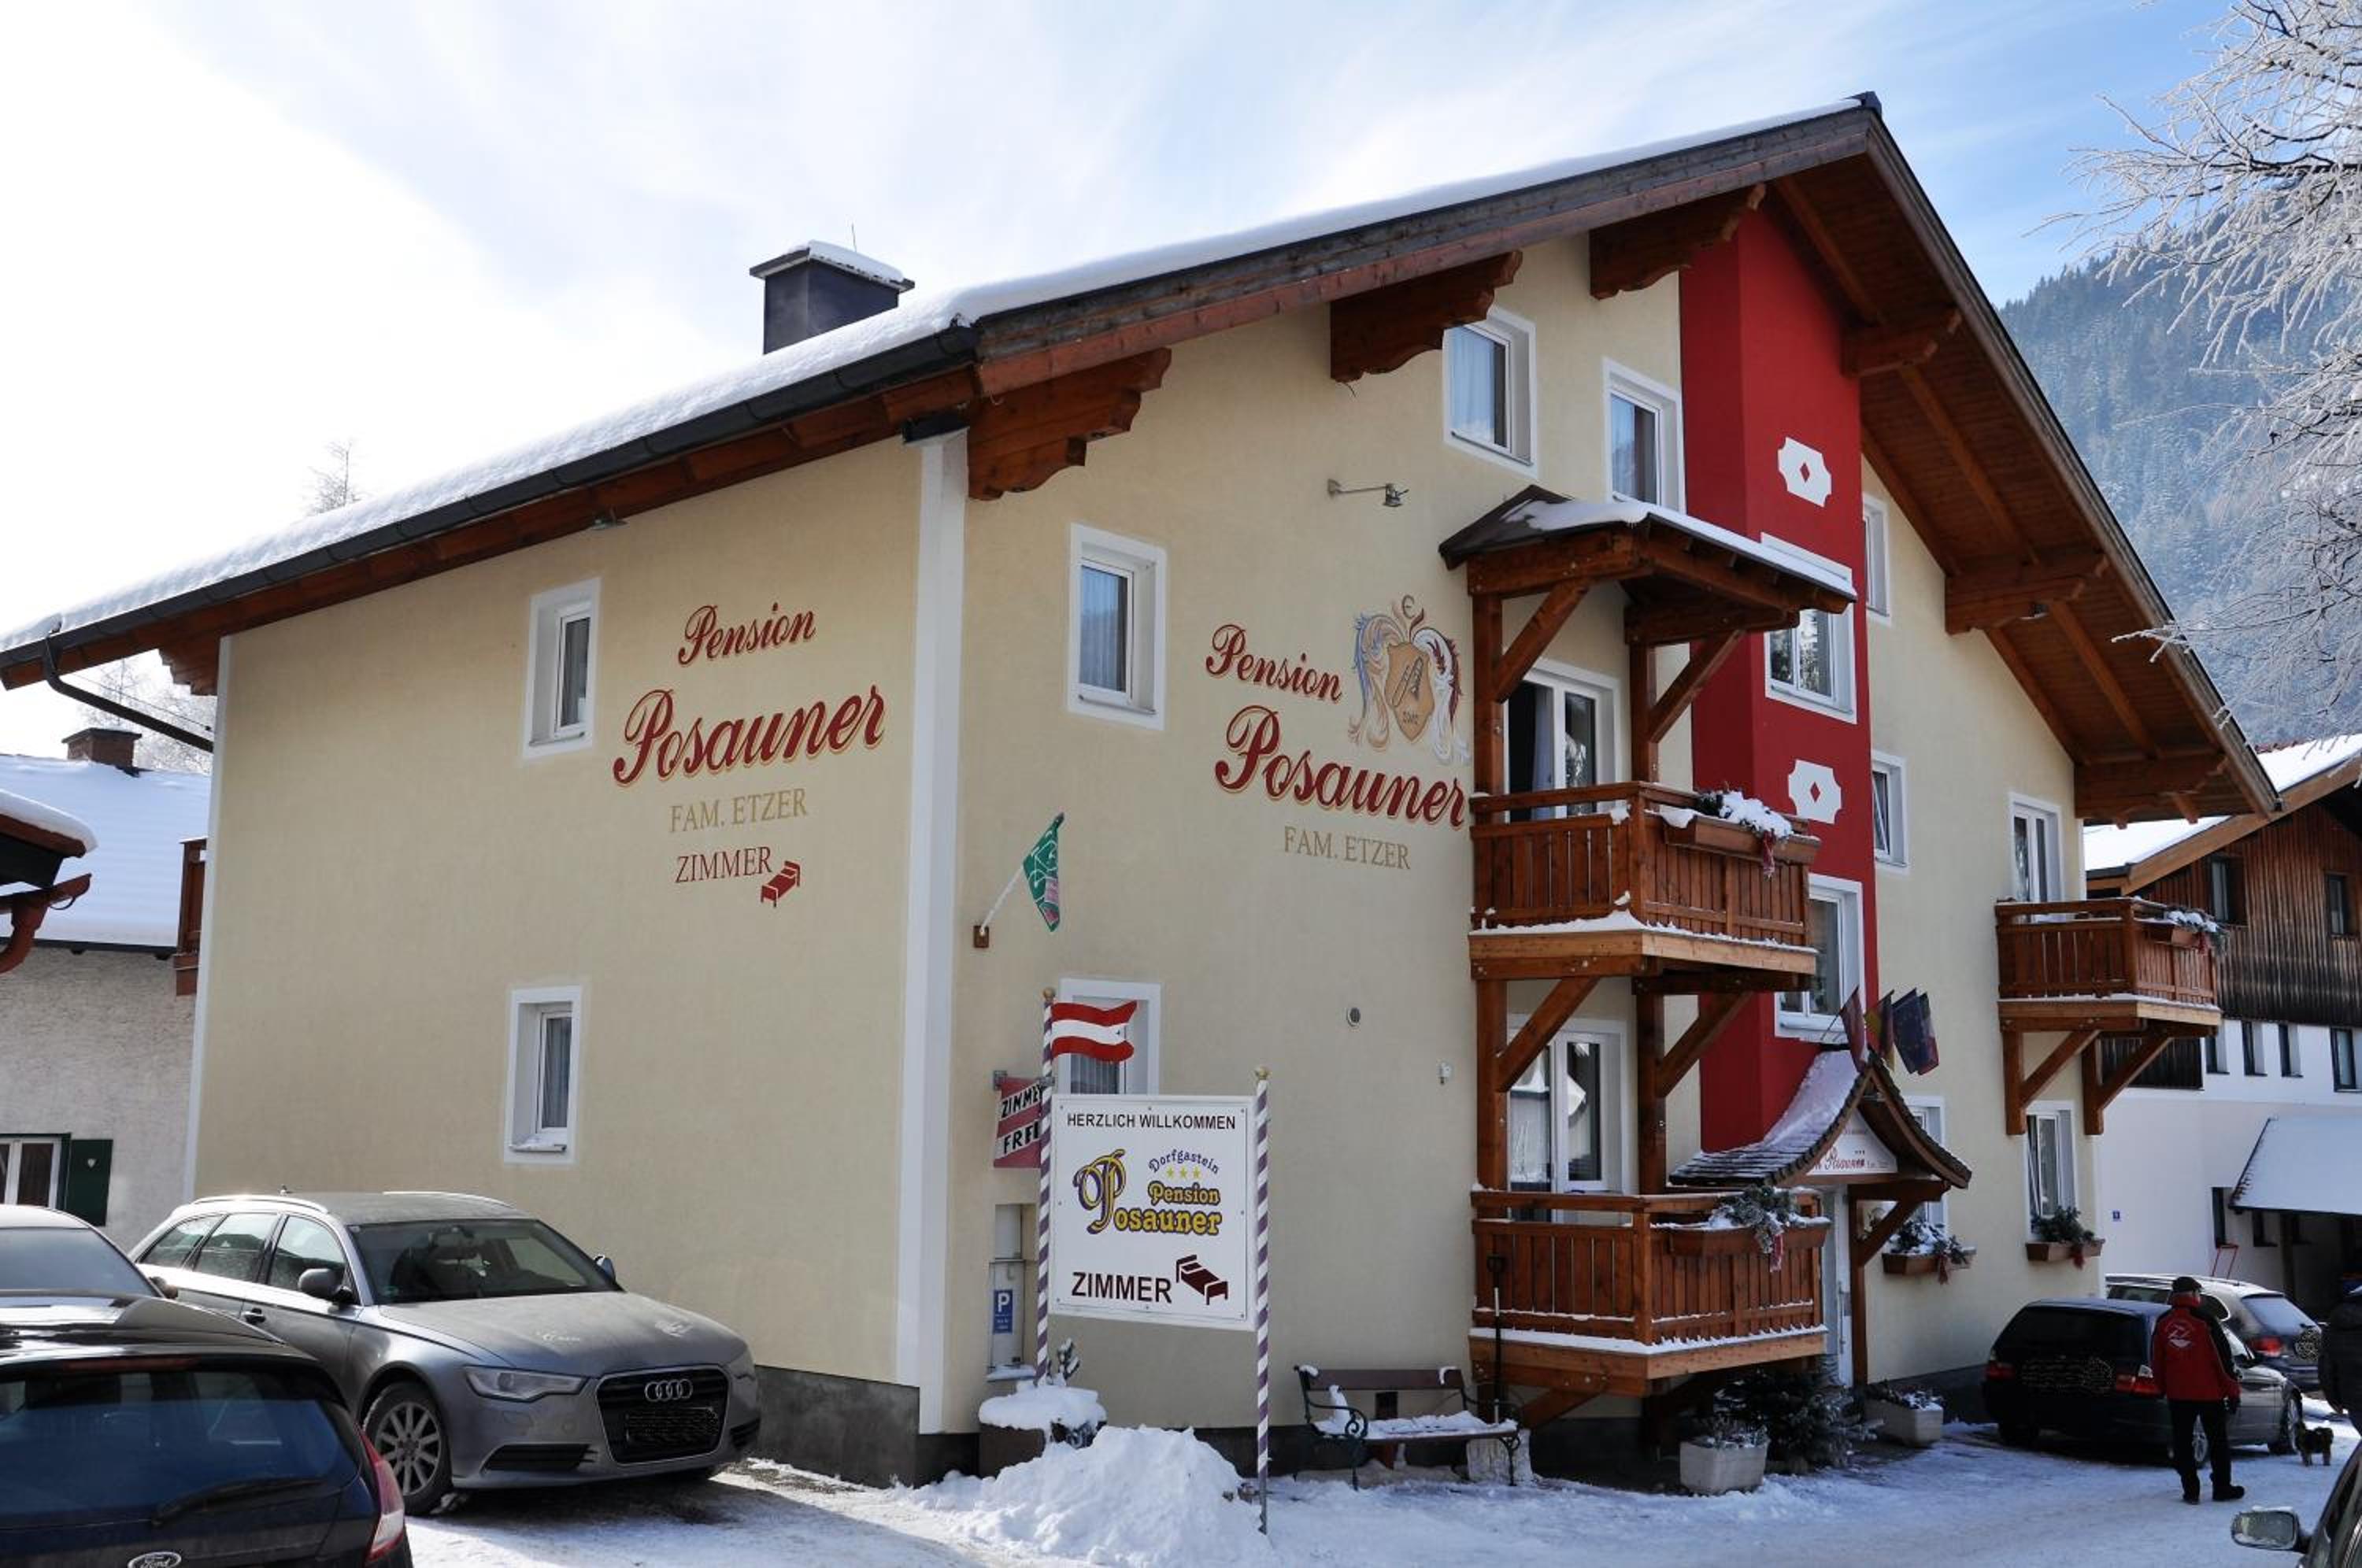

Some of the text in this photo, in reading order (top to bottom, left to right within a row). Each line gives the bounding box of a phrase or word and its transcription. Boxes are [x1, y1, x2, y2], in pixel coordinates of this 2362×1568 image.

[677, 601, 816, 666] Pension
[1205, 624, 1342, 703] Pension
[613, 684, 887, 786] Posauner
[1214, 704, 1466, 830] Posauner
[669, 788, 808, 833] FAM. ETZER
[675, 846, 772, 883] ZIMMER
[1283, 827, 1411, 870] FAM. ETZER
[1068, 1114, 1236, 1130] HERZLICH WILLKOMMEN
[1148, 1149, 1219, 1174] Dorfgastein
[1072, 1148, 1222, 1235] Posauner
[1148, 1181, 1220, 1206] Pension
[998, 1292, 1010, 1312] P
[1071, 1271, 1172, 1304] ZIMMER
